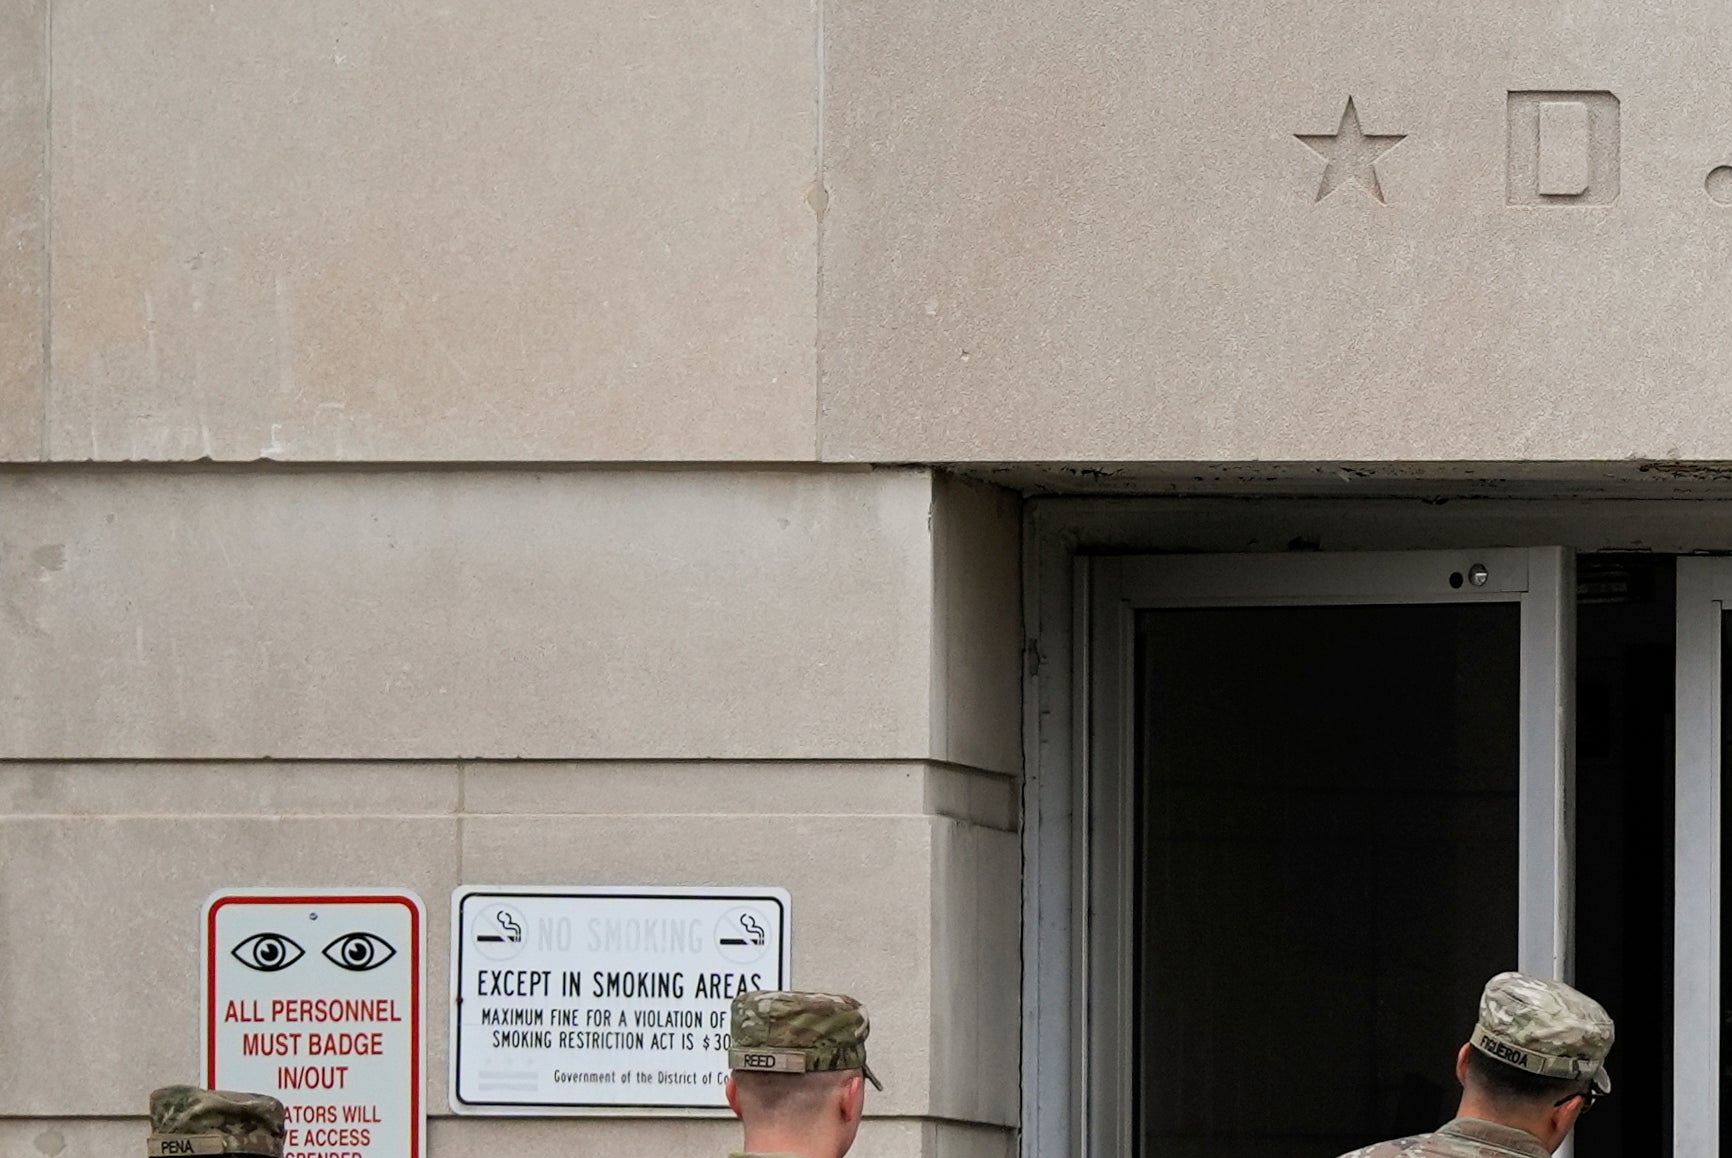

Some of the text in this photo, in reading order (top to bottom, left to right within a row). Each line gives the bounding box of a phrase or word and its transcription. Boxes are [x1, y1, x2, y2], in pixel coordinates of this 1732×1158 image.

[538, 917, 704, 953] NO SMOKING
[478, 970, 761, 999] EXCEPT IN SMOKING AREAS
[224, 999, 402, 1023] ALL PERSONNEL
[482, 1008, 727, 1029] MAXIMUM FINE FOR A VIOLATION OF
[243, 1033, 383, 1056] MUST BADGE
[492, 1030, 731, 1051] SMOKING RESTRICTION ACT IS $30
[743, 1054, 776, 1068] REED
[1480, 1035, 1528, 1068] FIGUEROA
[278, 1066, 348, 1089] IN/OUT
[554, 1069, 729, 1085] Government of the District of Co
[284, 1105, 382, 1123] ATORS WILL
[161, 1140, 195, 1154] PENA
[304, 1129, 370, 1147] ACCESS
